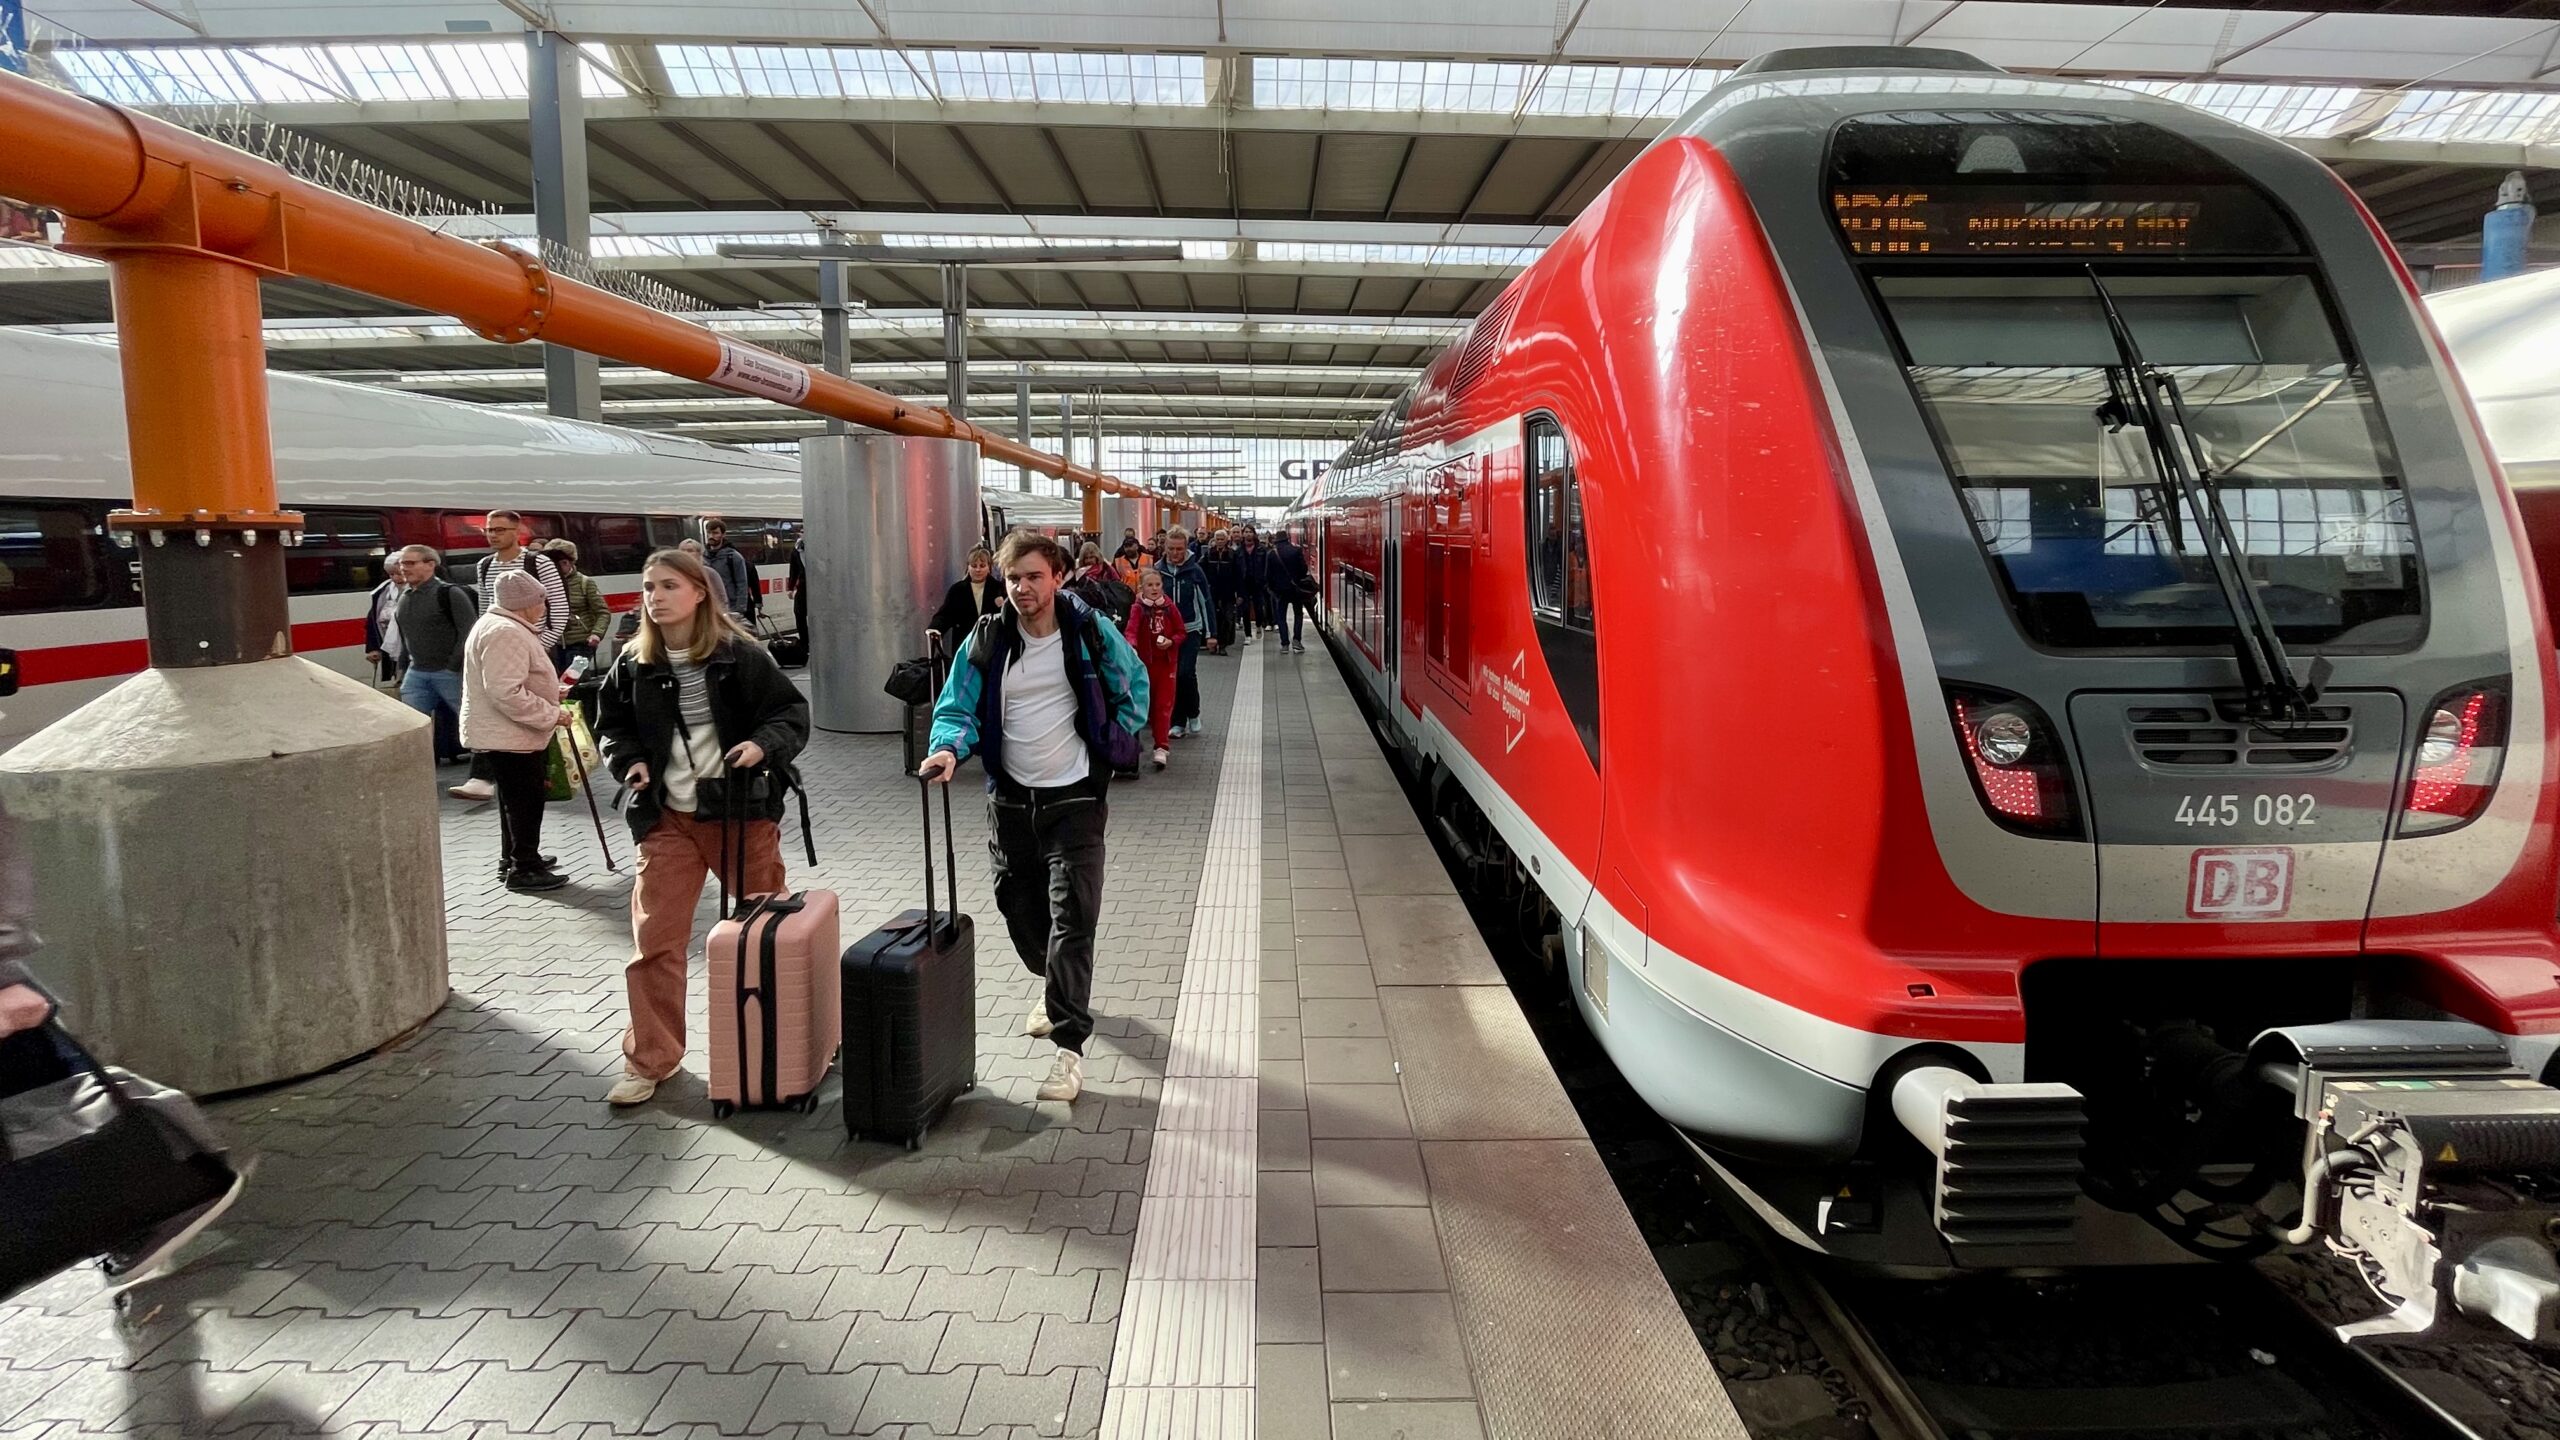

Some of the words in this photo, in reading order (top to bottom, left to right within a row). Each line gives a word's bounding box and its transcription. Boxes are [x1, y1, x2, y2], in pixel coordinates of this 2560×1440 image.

[1164, 475, 1175, 488] A
[2174, 794, 2239, 827] 445
[2253, 793, 2316, 826] 082
[2198, 857, 2282, 909] DB
